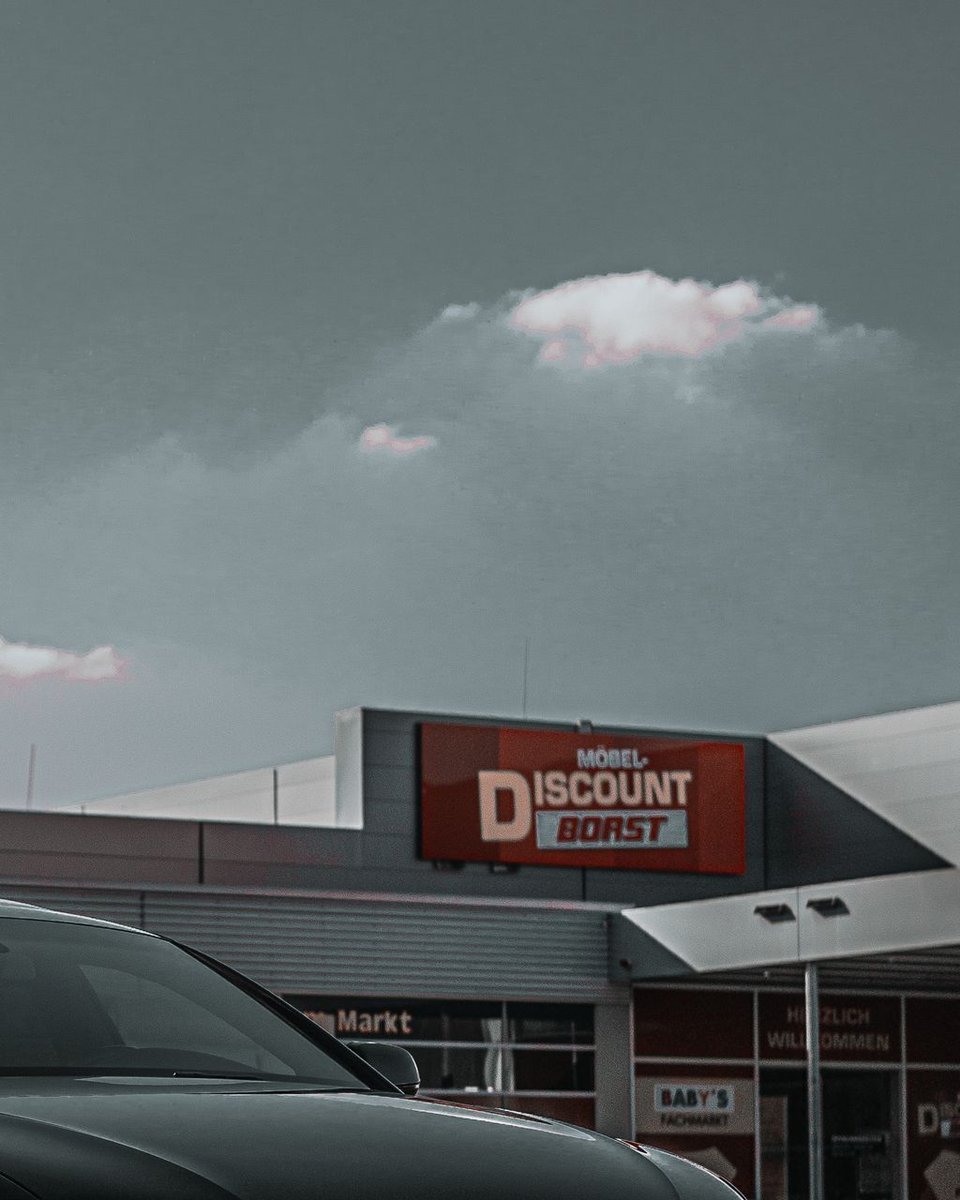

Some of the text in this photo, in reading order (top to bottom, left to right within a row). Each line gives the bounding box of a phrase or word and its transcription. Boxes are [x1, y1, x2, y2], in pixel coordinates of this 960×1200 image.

[478, 770, 692, 842] DISCOUNT
[557, 817, 667, 842] BORST
[338, 1009, 412, 1034] Markt
[787, 1007, 870, 1024] HZLICH
[767, 1032, 889, 1051] WILOMMEN
[661, 1088, 729, 1109] BABY'S
